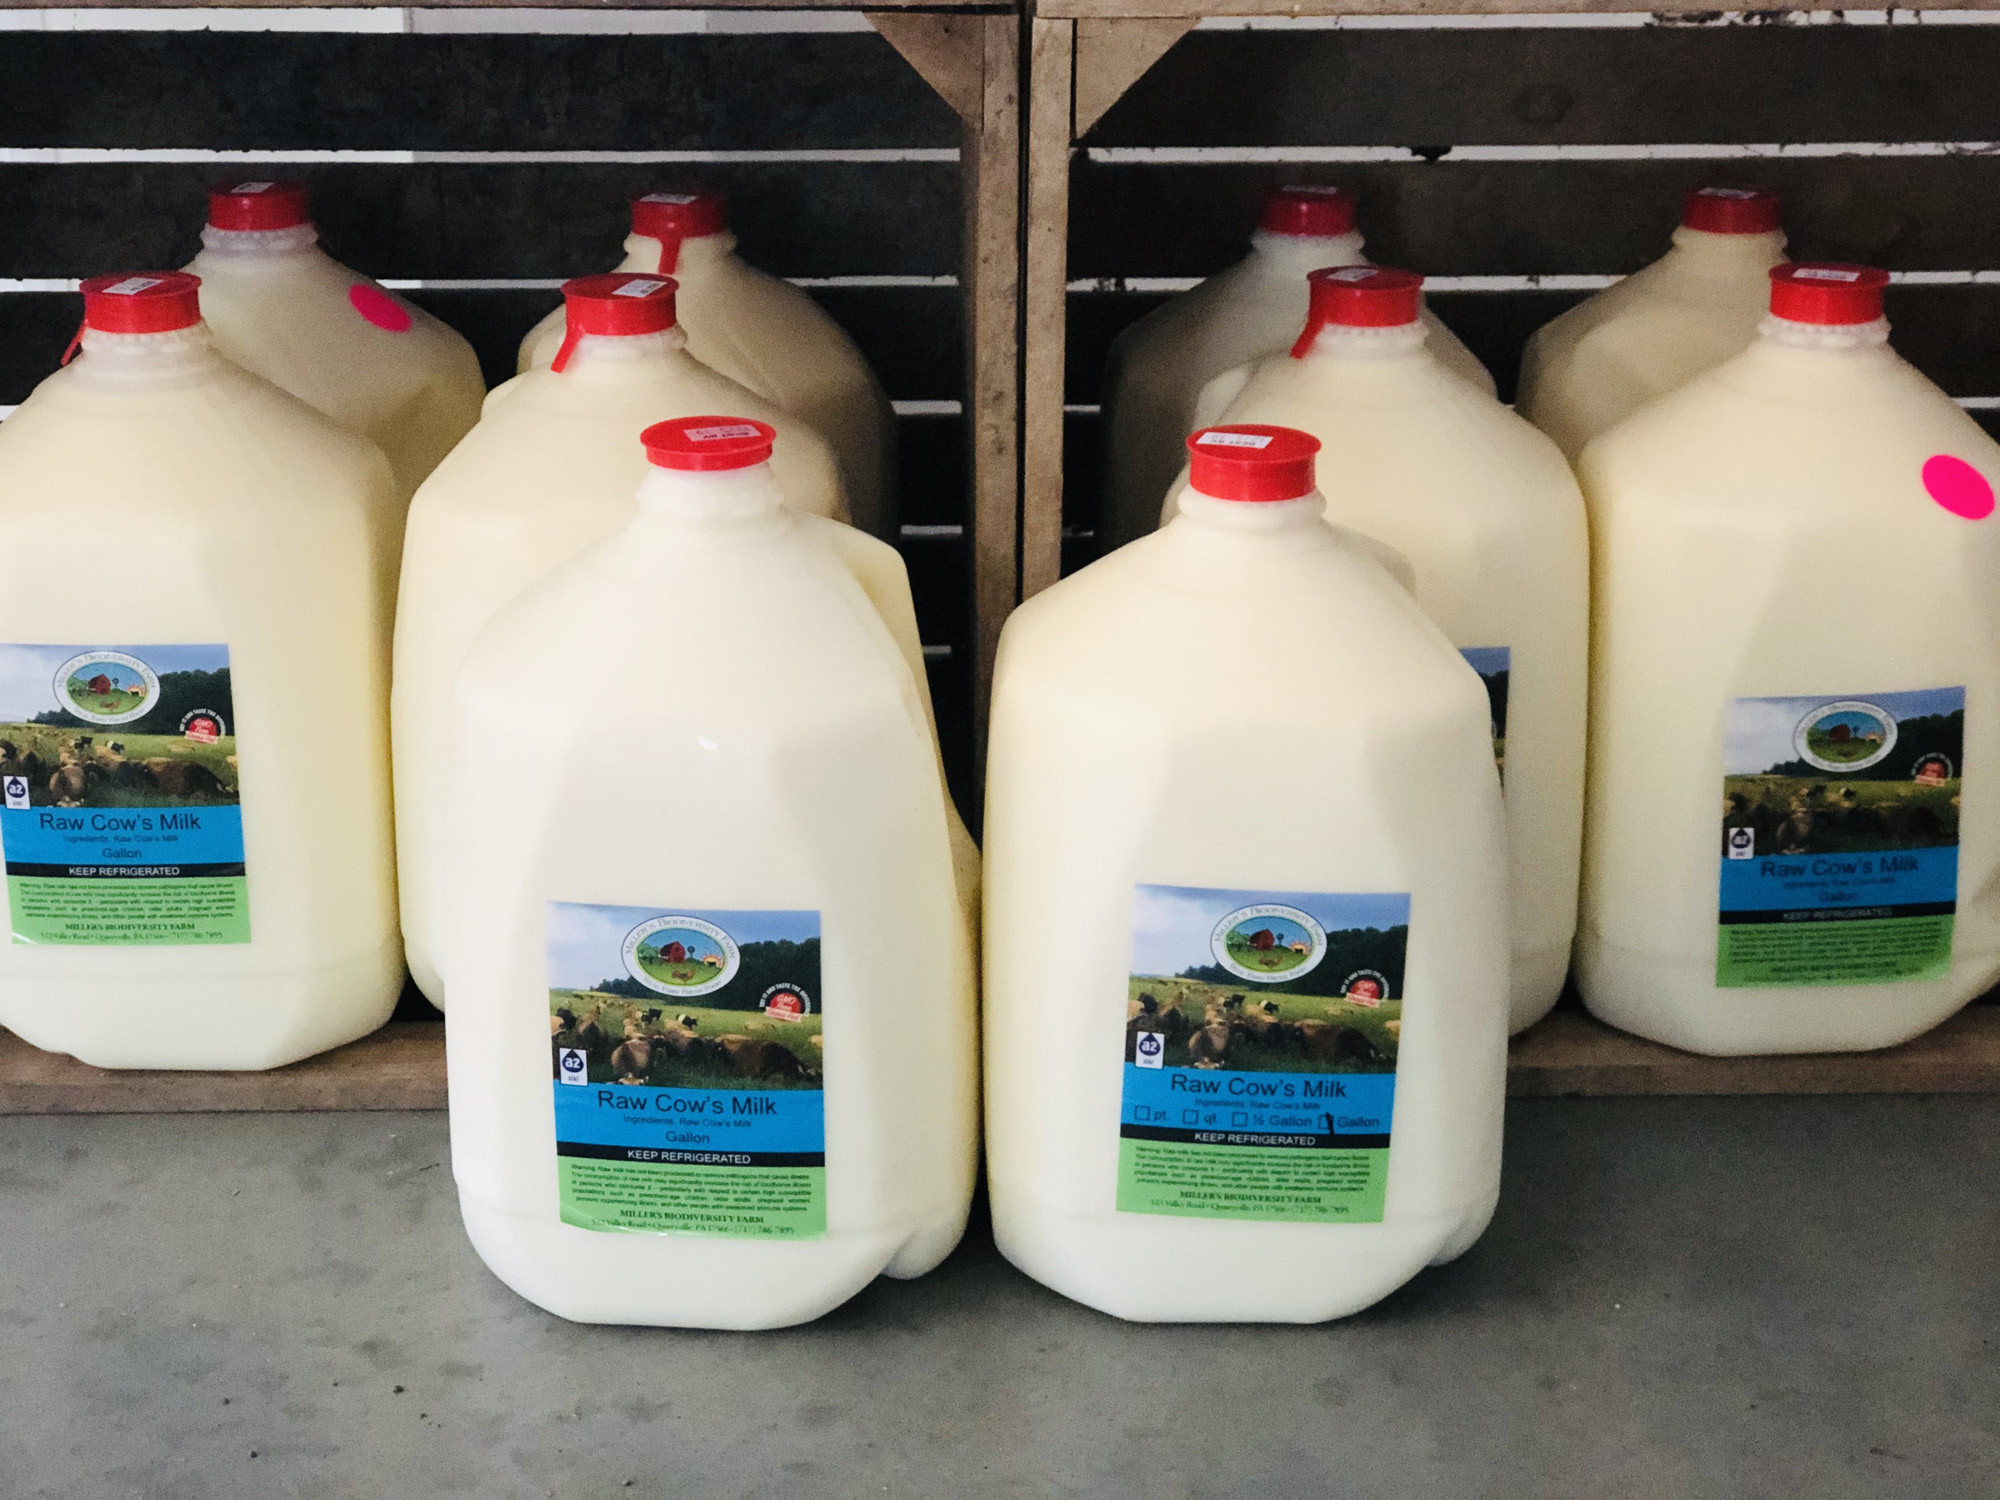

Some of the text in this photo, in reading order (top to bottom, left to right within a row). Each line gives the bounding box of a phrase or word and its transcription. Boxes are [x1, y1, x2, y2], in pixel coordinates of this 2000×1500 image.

[40, 813, 201, 831] Raw Cow's Milk
[114, 834, 132, 843] Raw
[102, 848, 142, 858] Gallon
[69, 866, 181, 876] KEEP REFRIGERATED
[1761, 856, 1920, 877] Raw Cow's Milk
[565, 1057, 582, 1069] a2
[1171, 1073, 1346, 1098] Raw Cow's Milk
[598, 1091, 777, 1115] Raw Cow's Milk
[679, 1117, 700, 1127] Raw
[733, 1119, 751, 1128] Milk
[1269, 1115, 1312, 1127] Gallon
[1337, 1115, 1380, 1128] Gallon
[665, 1131, 710, 1144] Gallon
[1195, 1133, 1316, 1146] KEEP REFRIGERATED
[627, 1149, 751, 1164] KEEP REFRIGERATED
[620, 1209, 662, 1219] MILLER'S
[664, 1211, 735, 1223] BIODIVERSITY
